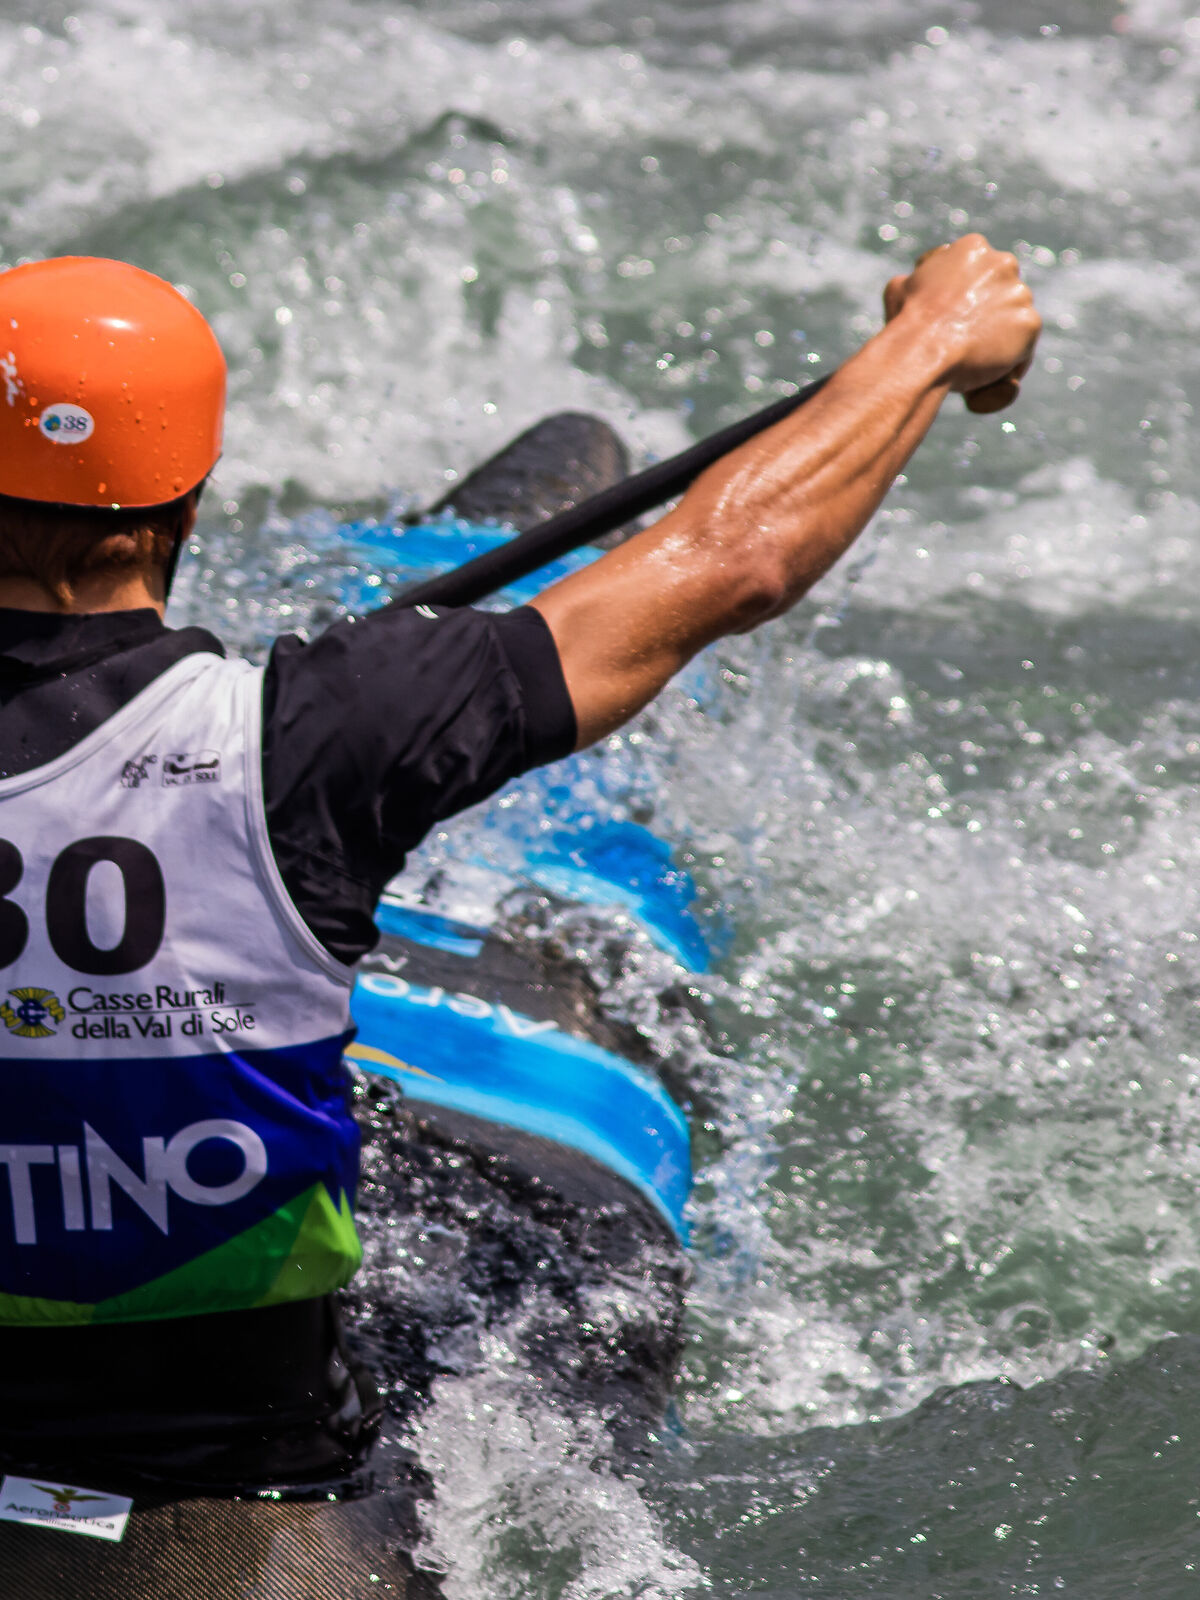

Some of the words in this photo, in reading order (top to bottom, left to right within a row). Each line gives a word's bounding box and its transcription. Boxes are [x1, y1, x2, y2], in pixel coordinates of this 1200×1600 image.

[63, 415, 88, 432] 38
[67, 987, 152, 1012] Casse
[155, 981, 226, 1008] Rurali
[71, 1017, 131, 1040] della
[132, 1015, 172, 1038] Val
[181, 1013, 203, 1036] di
[210, 1009, 256, 1034] Sole
[4, 1501, 115, 1530] Aeronautica
